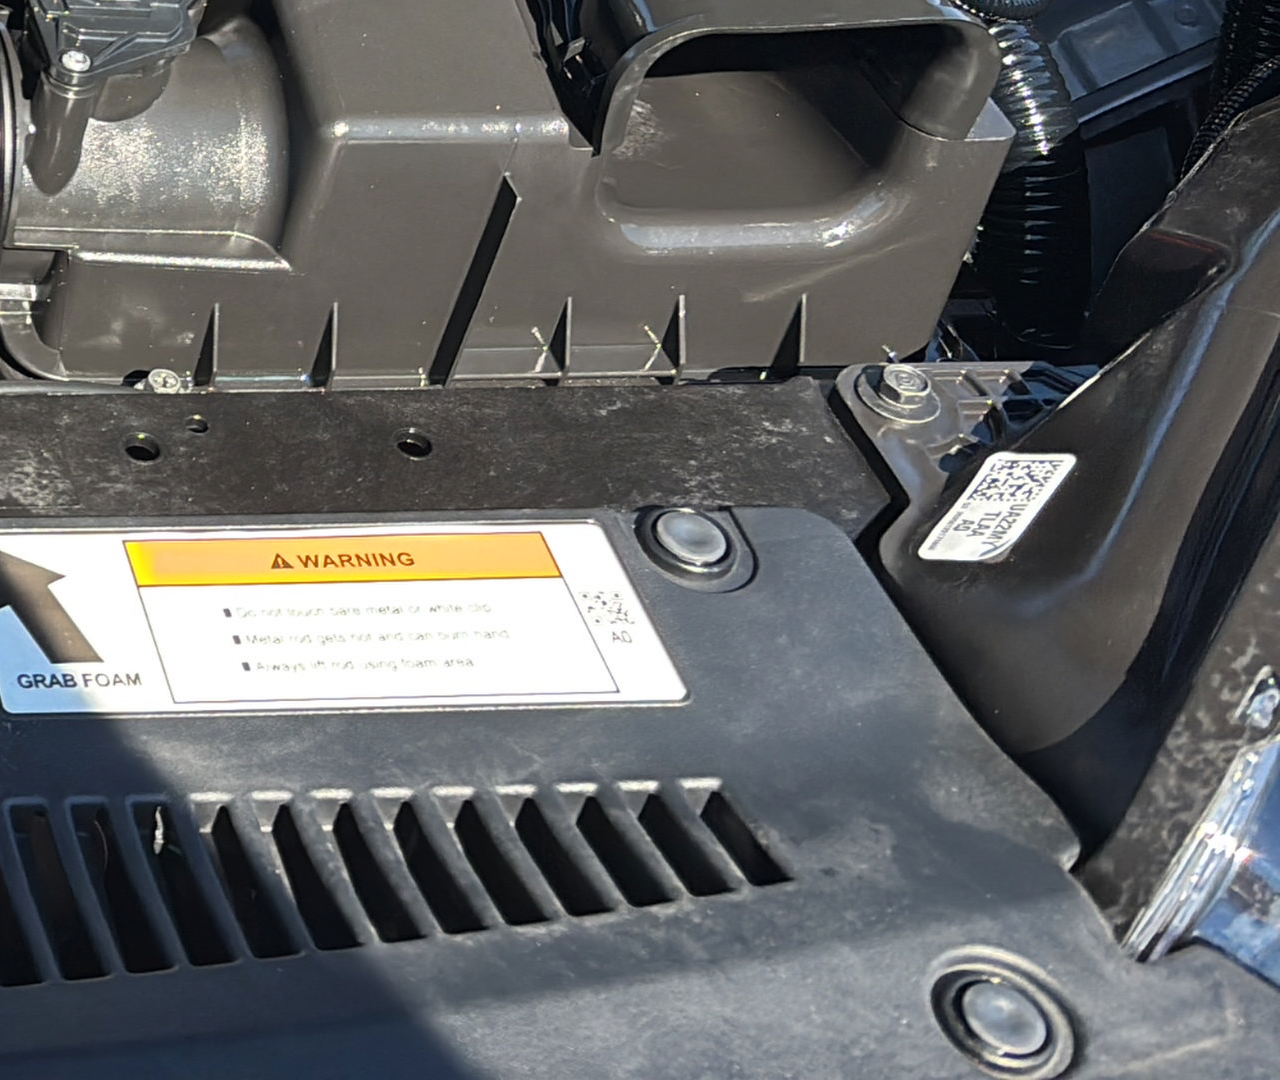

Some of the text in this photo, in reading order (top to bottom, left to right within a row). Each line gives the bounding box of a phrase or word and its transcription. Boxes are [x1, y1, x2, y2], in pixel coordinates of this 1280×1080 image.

[966, 510, 1003, 537] TLAA
[297, 551, 416, 570] WARNING
[16, 672, 143, 689] GRAB FOAM
